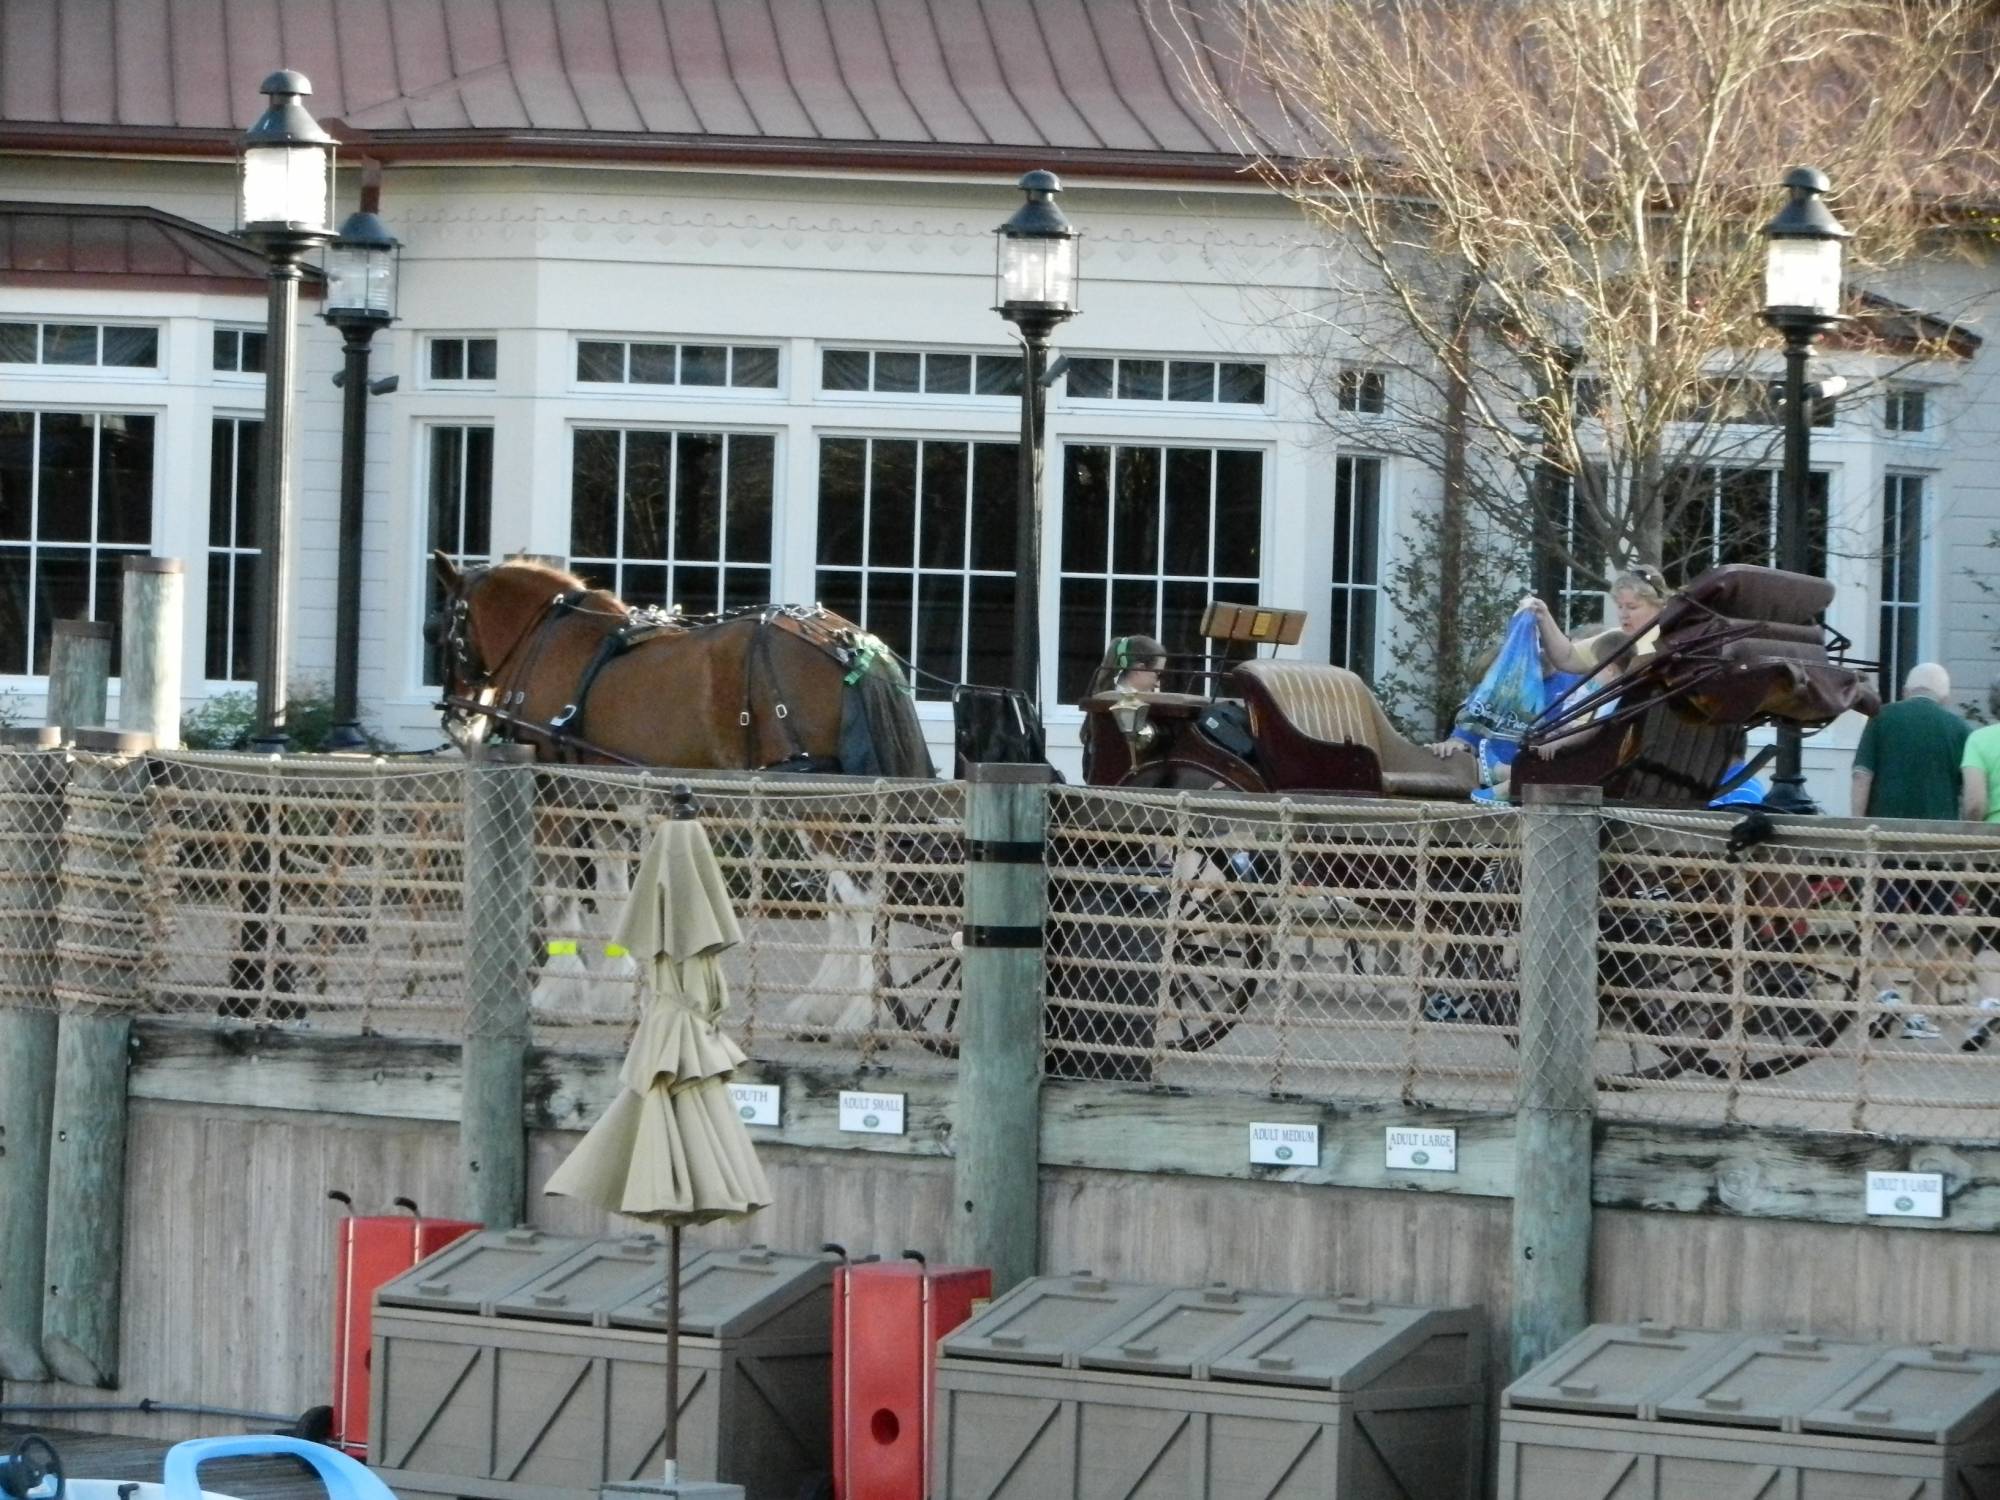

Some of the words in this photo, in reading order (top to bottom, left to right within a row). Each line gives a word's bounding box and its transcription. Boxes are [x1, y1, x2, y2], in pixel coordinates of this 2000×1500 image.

[1468, 699, 1505, 728] Disney
[843, 1097, 870, 1110] ADULT
[872, 1098, 901, 1112] SMALL
[1253, 1128, 1279, 1141] ADULT
[1282, 1129, 1315, 1143] MEDIUM
[1390, 1133, 1419, 1146] ADULT
[1422, 1134, 1452, 1147] LARGE
